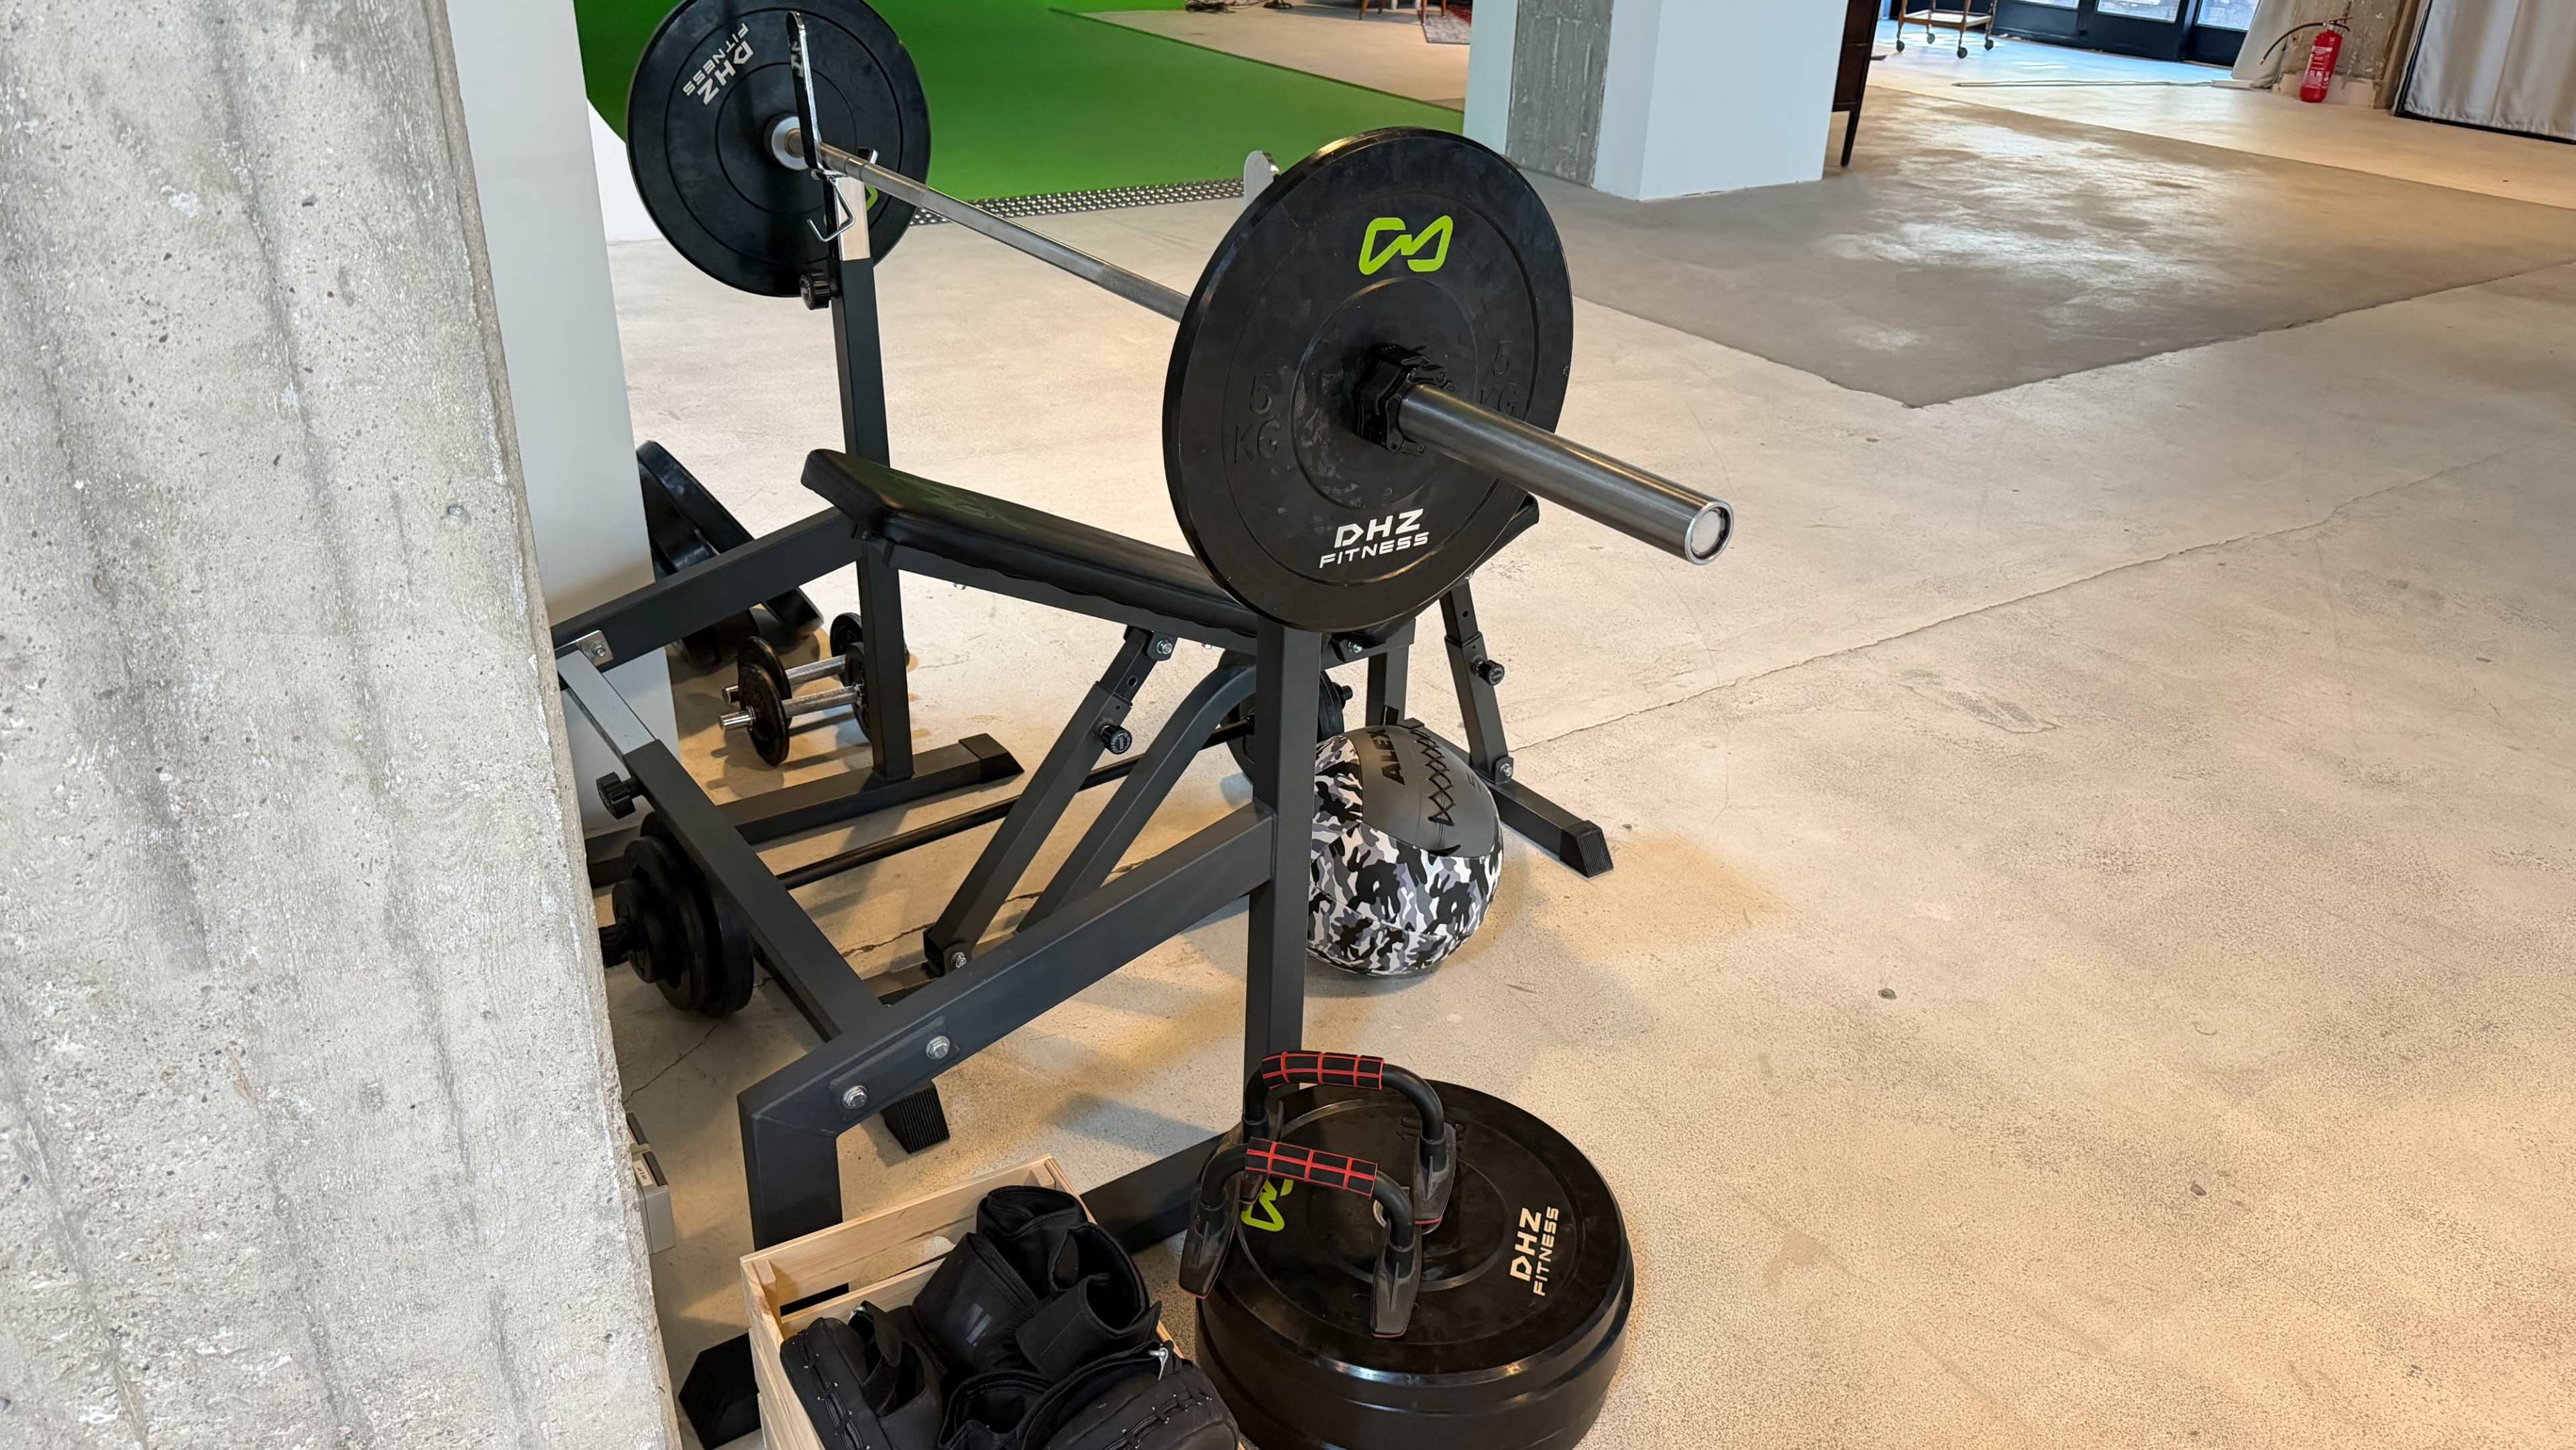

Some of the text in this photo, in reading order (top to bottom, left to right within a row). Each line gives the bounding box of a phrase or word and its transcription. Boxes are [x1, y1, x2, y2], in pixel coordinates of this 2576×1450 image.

[682, 23, 749, 96] FITNESS
[697, 40, 753, 105] DHZ
[1319, 531, 1430, 568] FITNESS
[1334, 509, 1424, 548] DHZ
[1367, 729, 1405, 785] ALEX
[1509, 1207, 1542, 1282] DHZ
[1533, 1206, 1560, 1296] FITNESS
